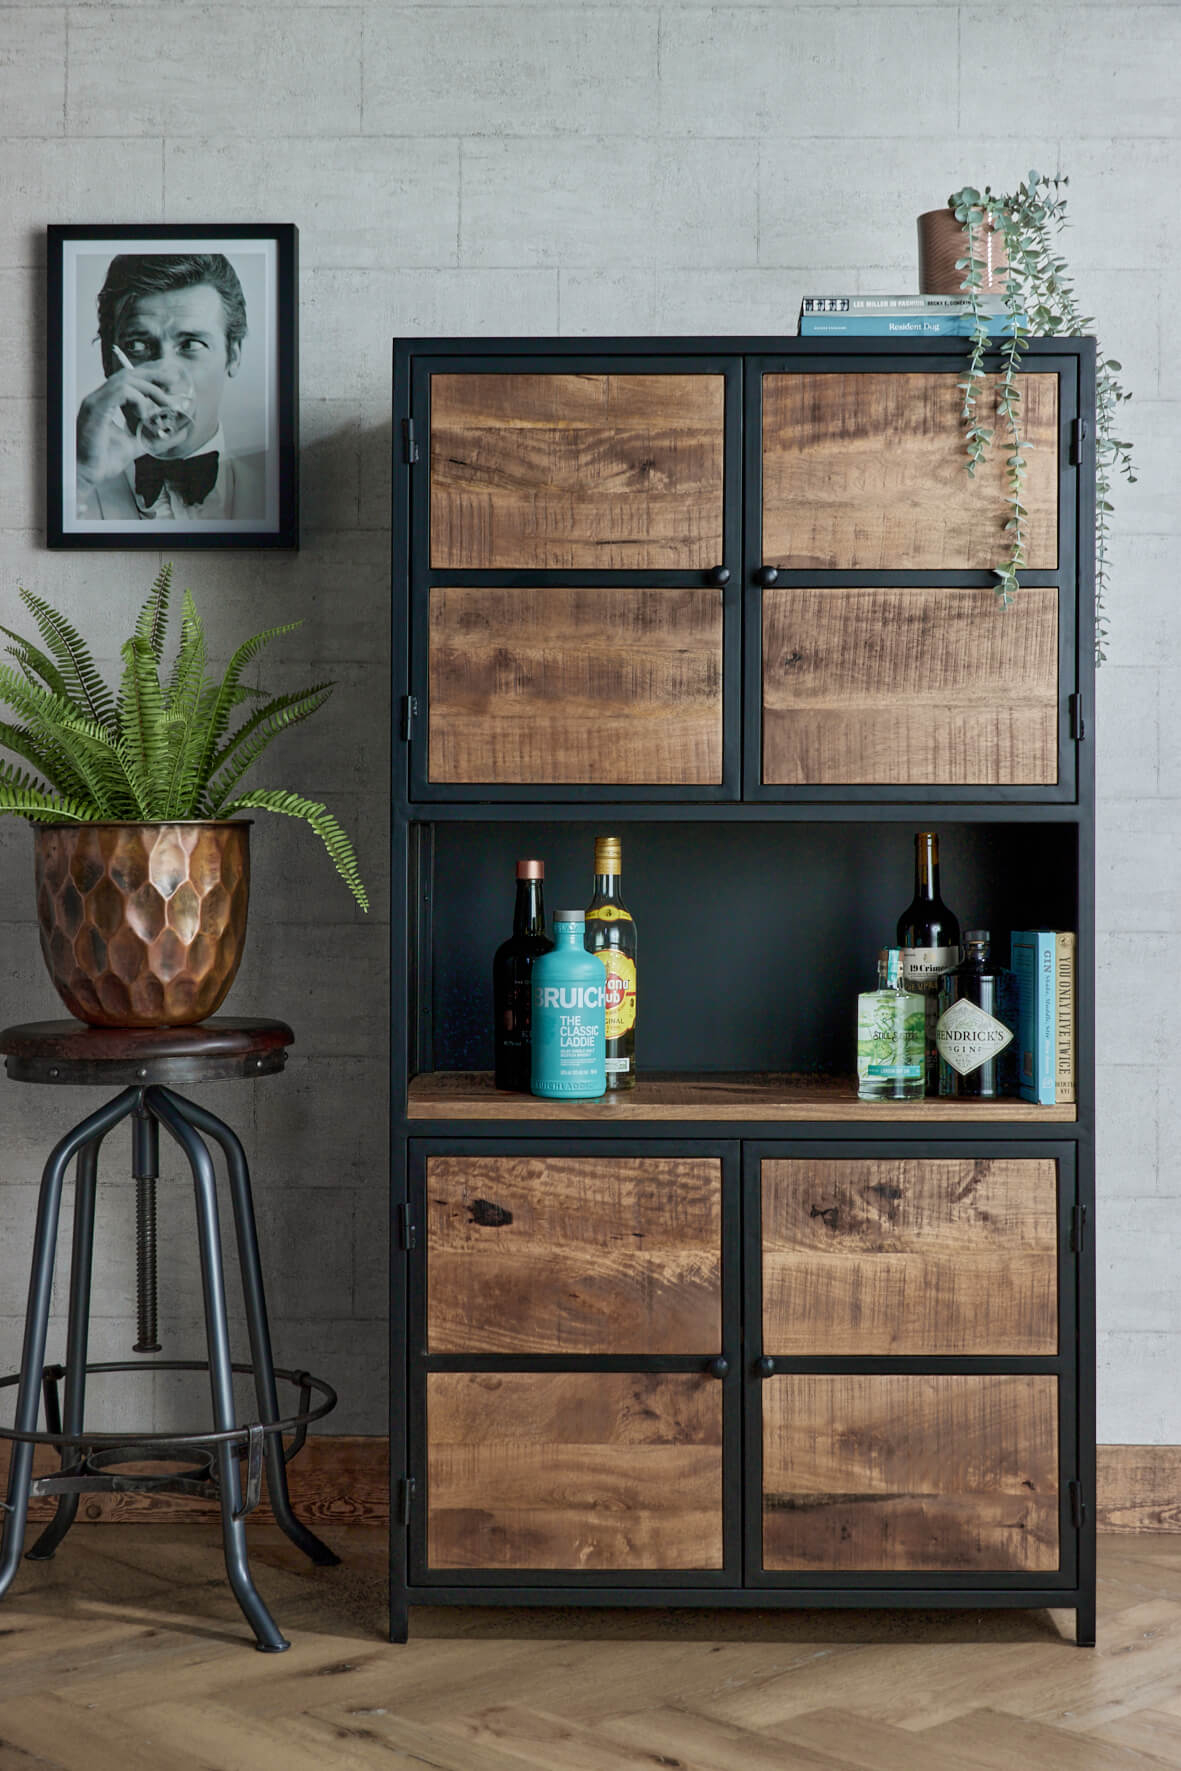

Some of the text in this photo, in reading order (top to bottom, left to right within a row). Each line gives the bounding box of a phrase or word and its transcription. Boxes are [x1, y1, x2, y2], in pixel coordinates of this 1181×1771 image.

[888, 322, 921, 331] Resident
[1044, 950, 1052, 973] GIN
[910, 964, 918, 972] 19
[1059, 957, 1071, 978] YOU
[1059, 981, 1071, 1009] ONLY
[560, 1016, 581, 1026] THE
[1059, 1012, 1071, 1037] LIVE
[560, 1026, 599, 1036] CLASSIC
[873, 1030, 891, 1040] STILL
[937, 1030, 1004, 1040] HENDRICK'S
[560, 1036, 596, 1048] LADDIE
[1059, 1040, 1071, 1074] TWICE
